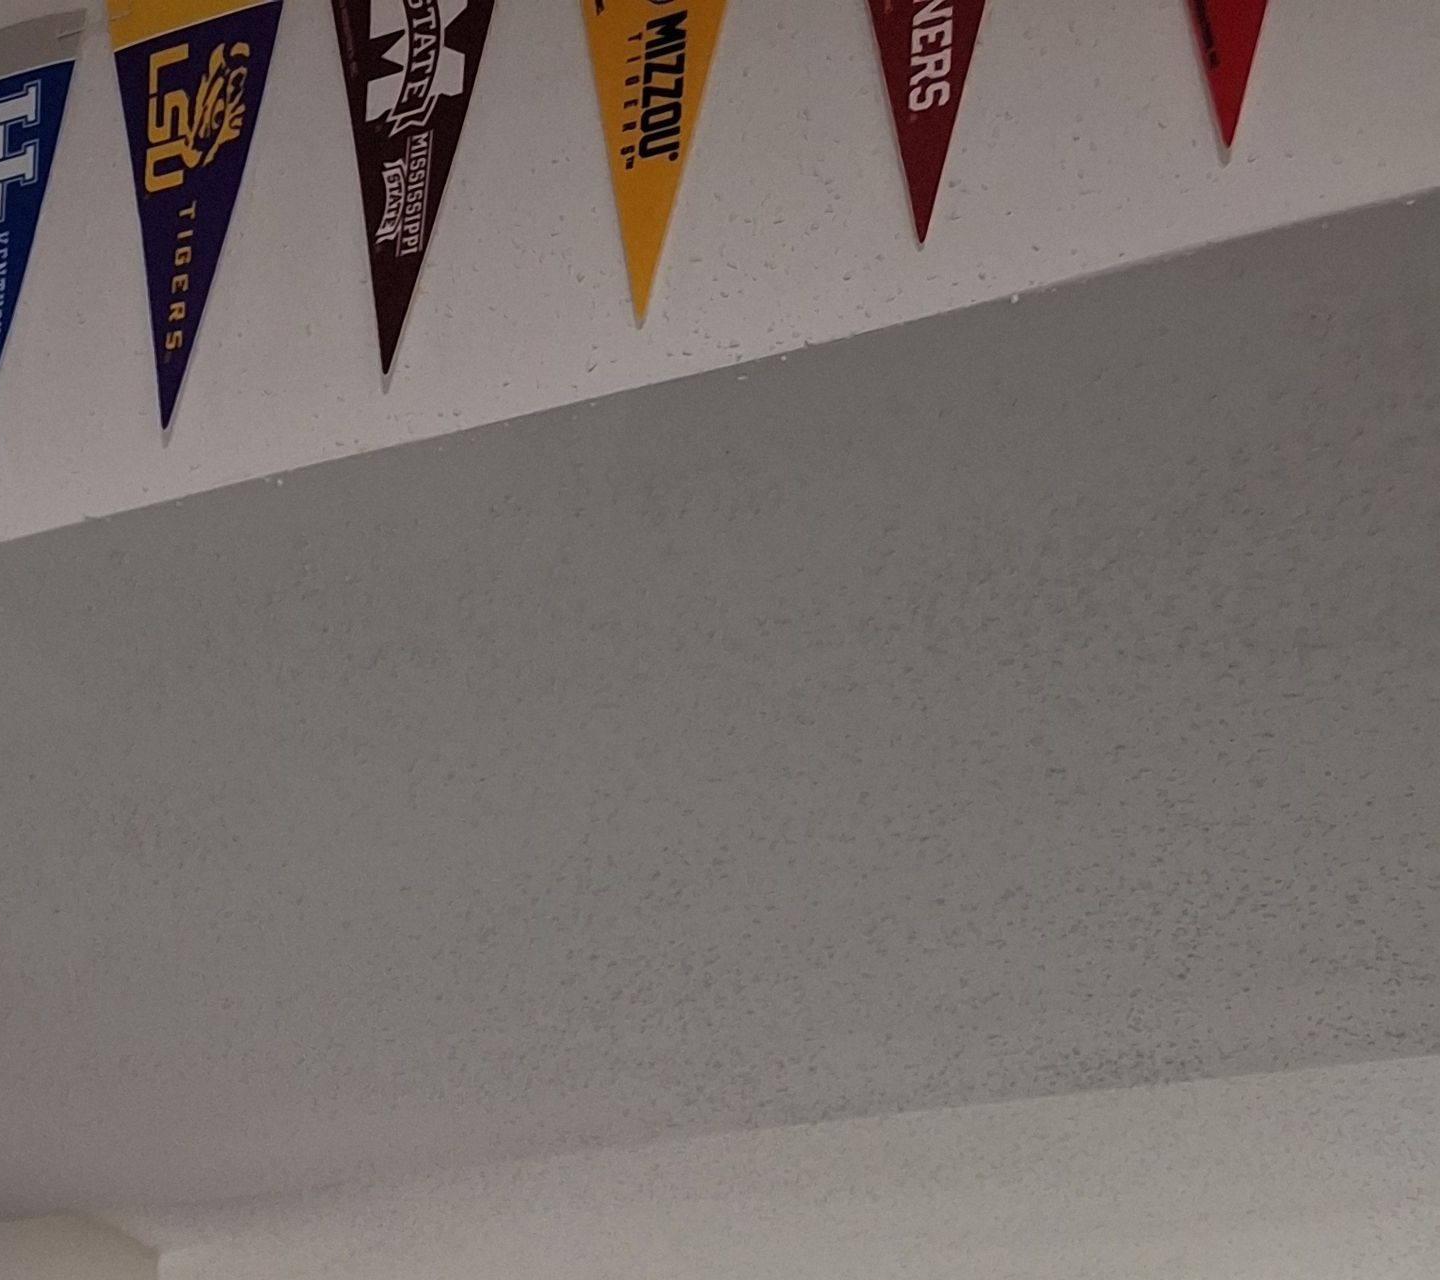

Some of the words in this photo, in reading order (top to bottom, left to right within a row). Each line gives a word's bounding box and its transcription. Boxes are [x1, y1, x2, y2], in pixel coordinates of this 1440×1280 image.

[144, 43, 195, 193] LSU
[638, 9, 688, 159] MIZZOU
[381, 173, 403, 230] STATE
[399, 133, 429, 256] MISSISSIPPI
[163, 201, 197, 351] TIGERS
